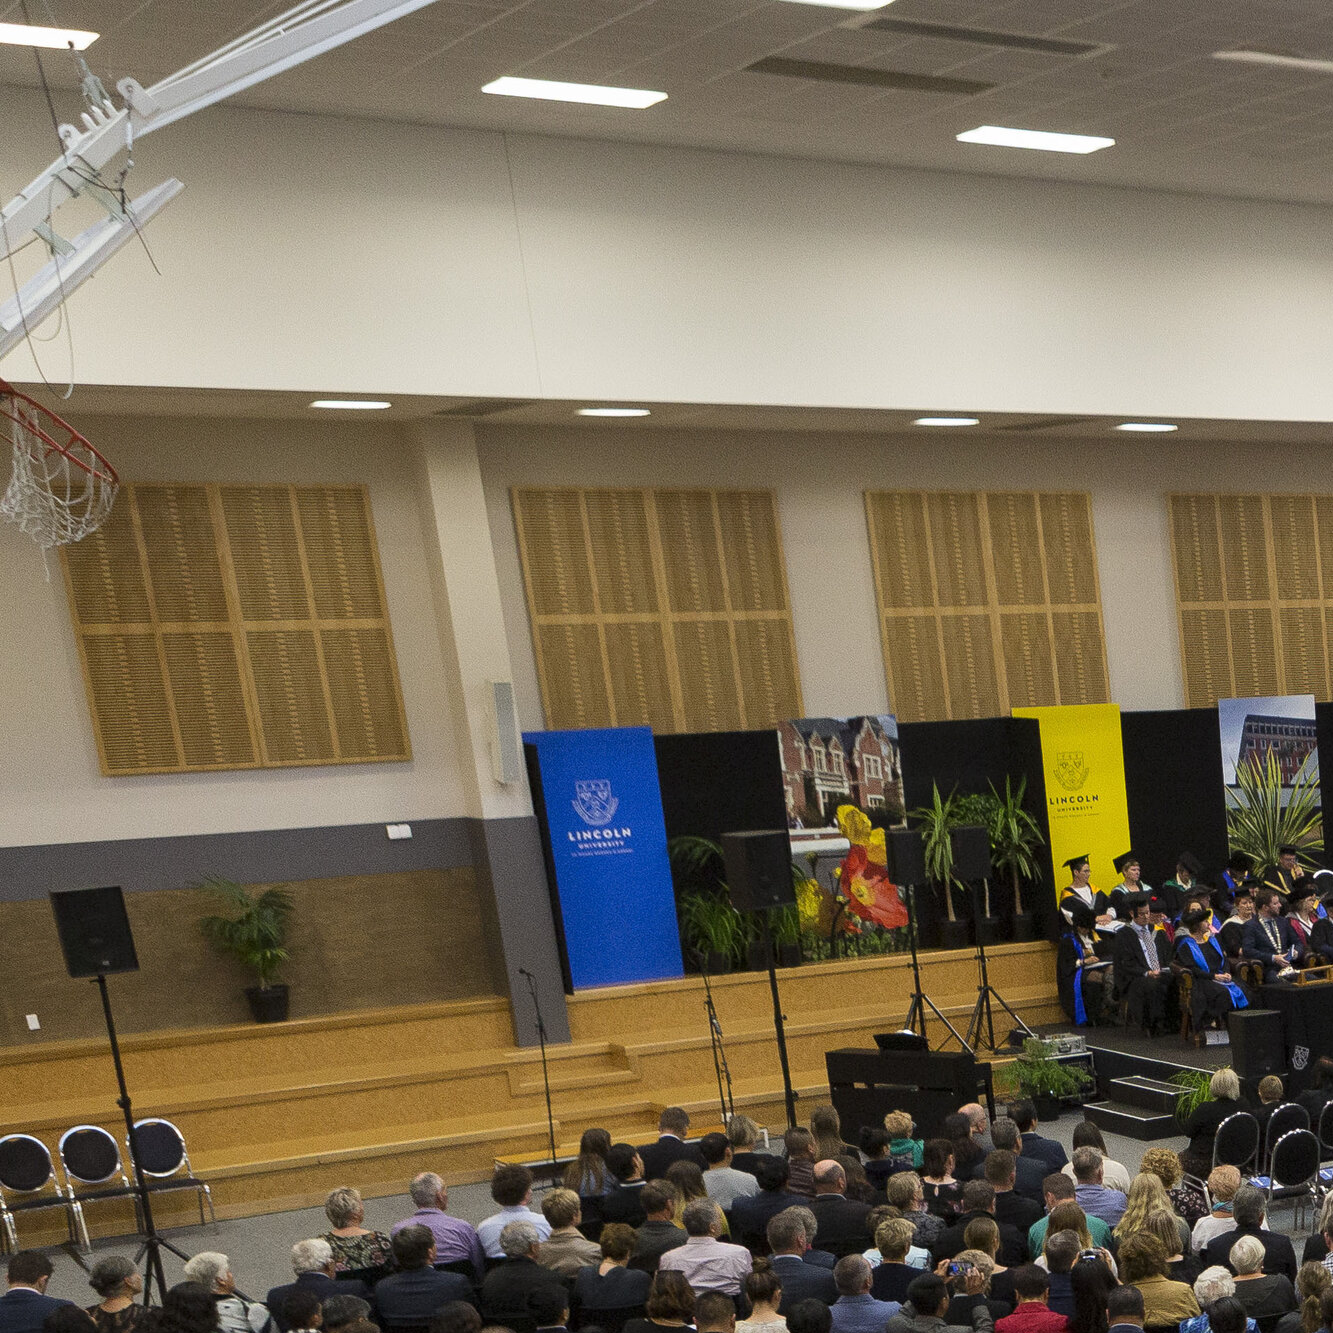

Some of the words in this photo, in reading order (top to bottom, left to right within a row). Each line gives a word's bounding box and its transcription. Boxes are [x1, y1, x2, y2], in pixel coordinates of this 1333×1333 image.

[1049, 794, 1099, 805] LINCOLN
[567, 827, 632, 841] LINCOLN
[578, 840, 624, 849] UNIVERSITY
